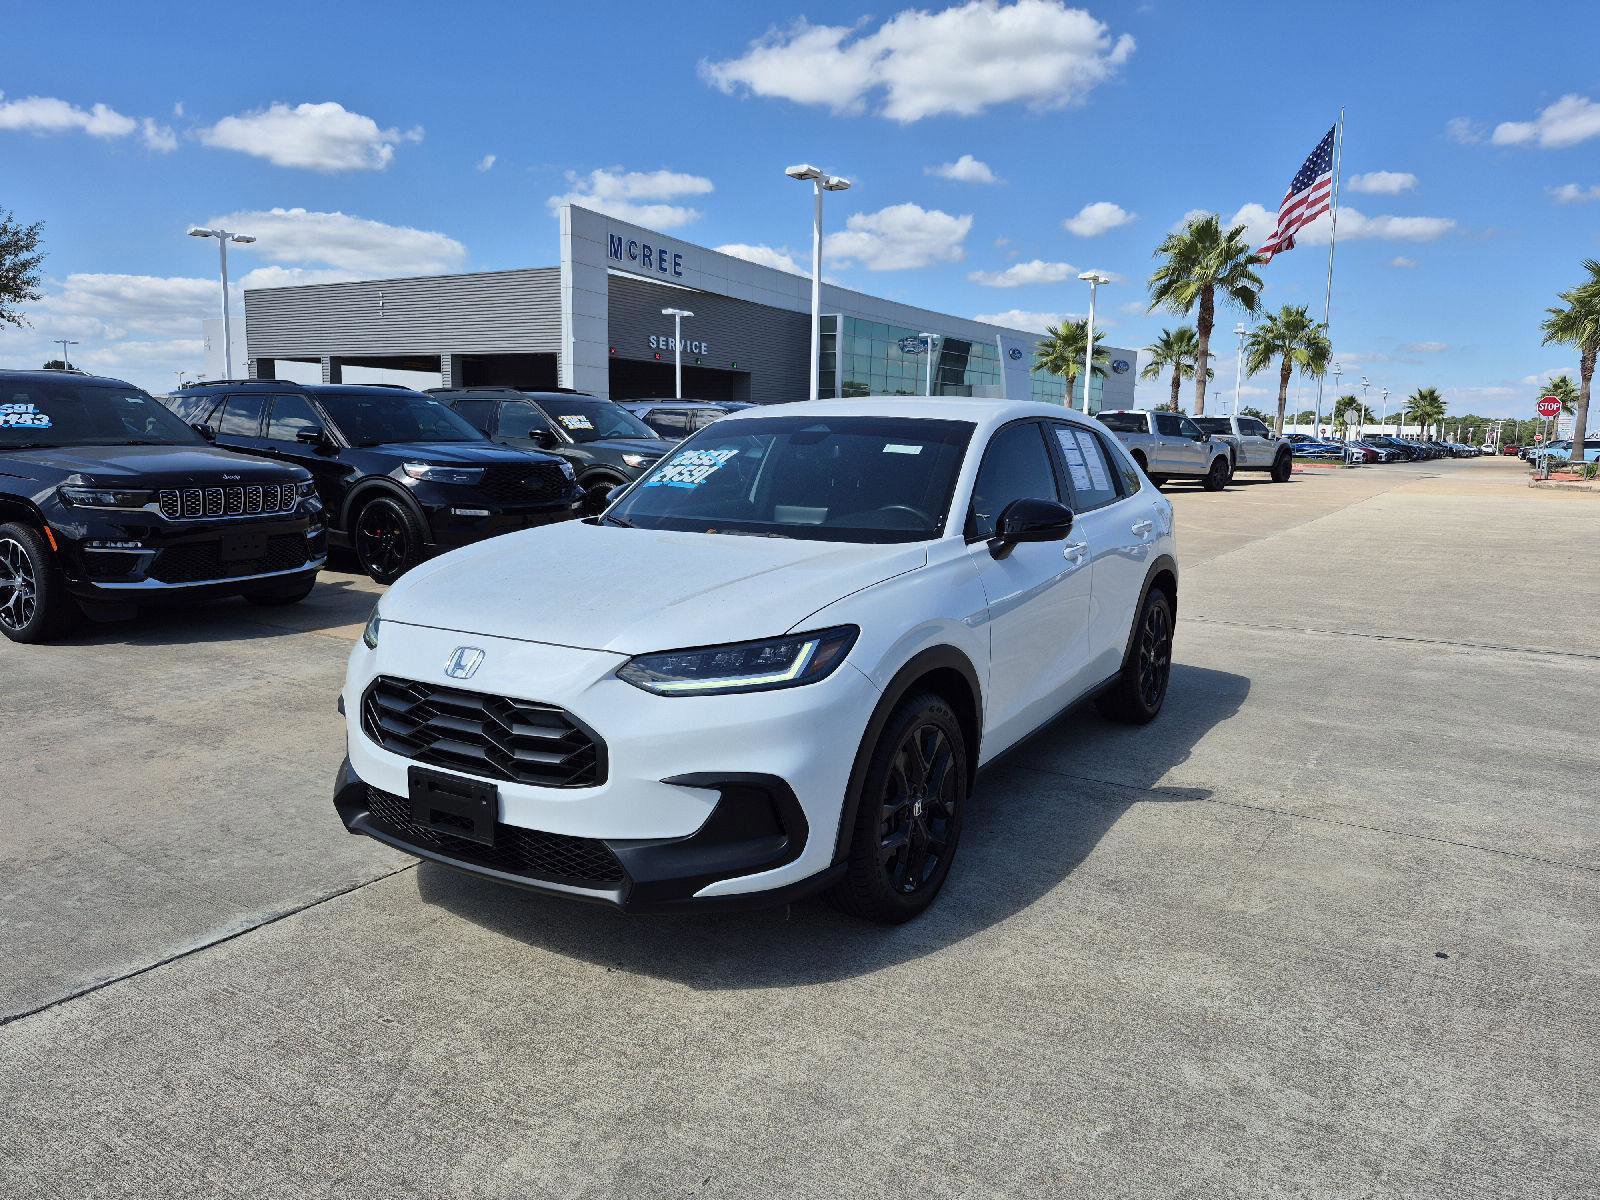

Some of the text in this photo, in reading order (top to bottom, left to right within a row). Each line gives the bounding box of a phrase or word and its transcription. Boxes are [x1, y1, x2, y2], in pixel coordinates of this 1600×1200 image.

[609, 233, 683, 277] MCREE
[649, 335, 708, 355] SERVICE
[1539, 402, 1560, 411] STOP
